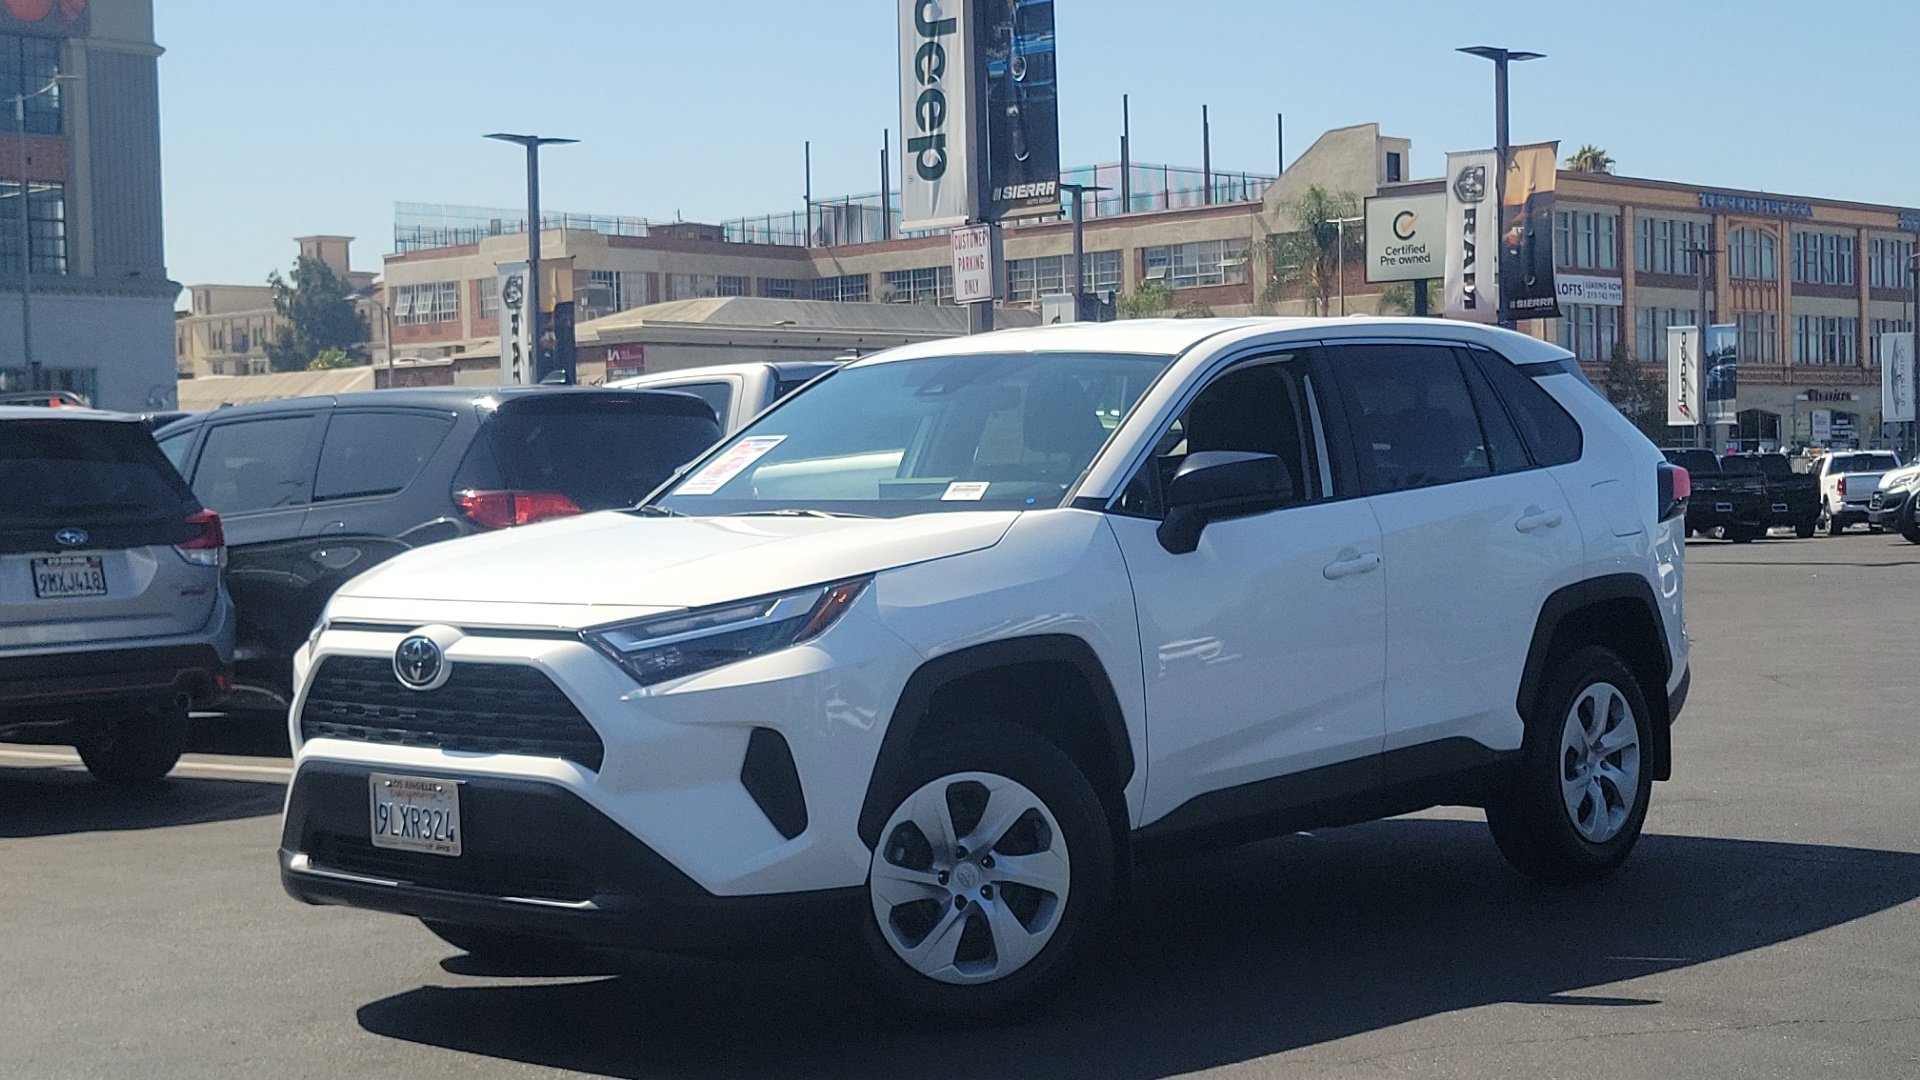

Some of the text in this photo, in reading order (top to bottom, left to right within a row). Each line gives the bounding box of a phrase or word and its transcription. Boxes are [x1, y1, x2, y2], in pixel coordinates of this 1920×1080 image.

[907, 0, 957, 181] Jeep
[1002, 181, 1056, 200] SIERRA
[954, 230, 987, 251] CUSTOMER
[1385, 242, 1426, 256] Certified
[958, 253, 984, 273] PARKING
[1463, 208, 1477, 310] RAM
[964, 279, 980, 296] ONLY
[1557, 283, 1583, 296] LOFTS
[1516, 297, 1555, 309] SIERRA
[379, 802, 455, 842] 9LXR324
